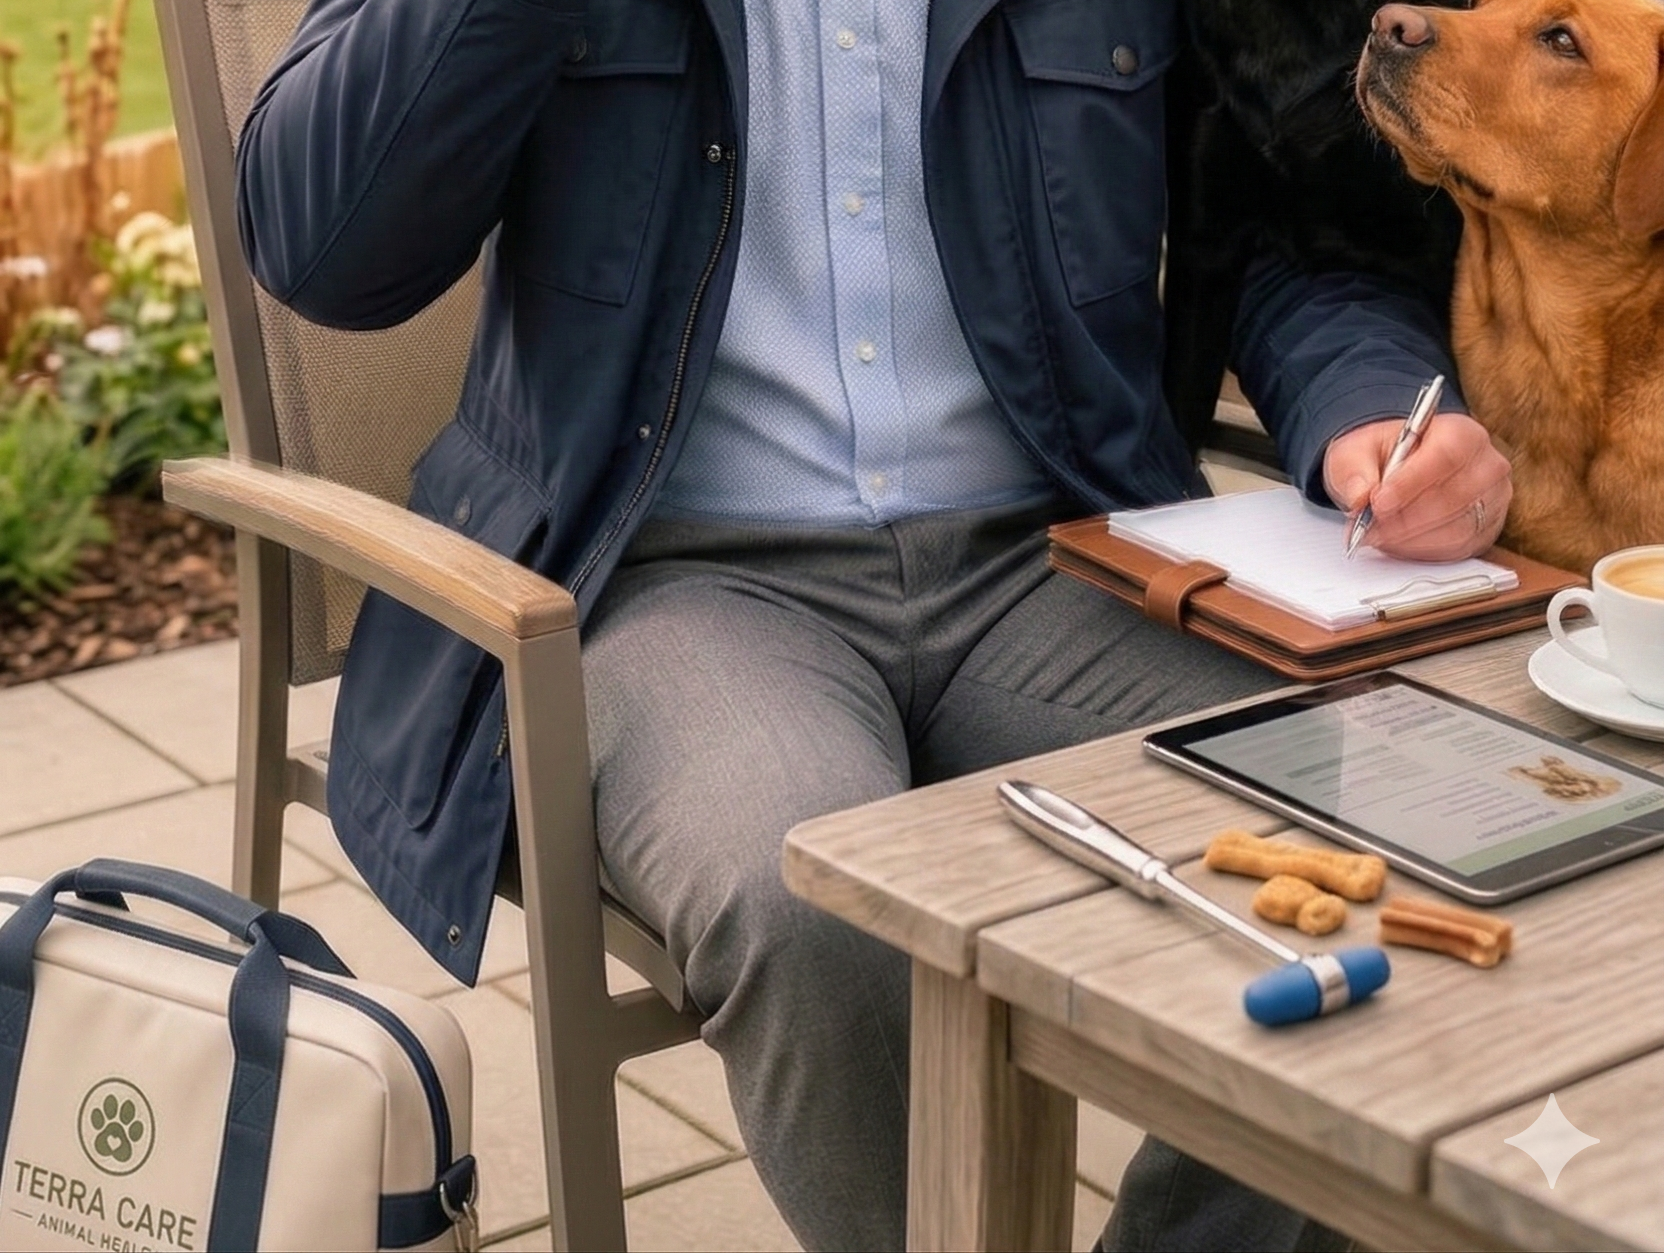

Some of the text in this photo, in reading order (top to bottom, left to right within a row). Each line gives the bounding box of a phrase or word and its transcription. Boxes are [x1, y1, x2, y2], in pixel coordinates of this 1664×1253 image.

[15, 1160, 197, 1251] TERRA CARE
[38, 1214, 95, 1245] ANIMAL
